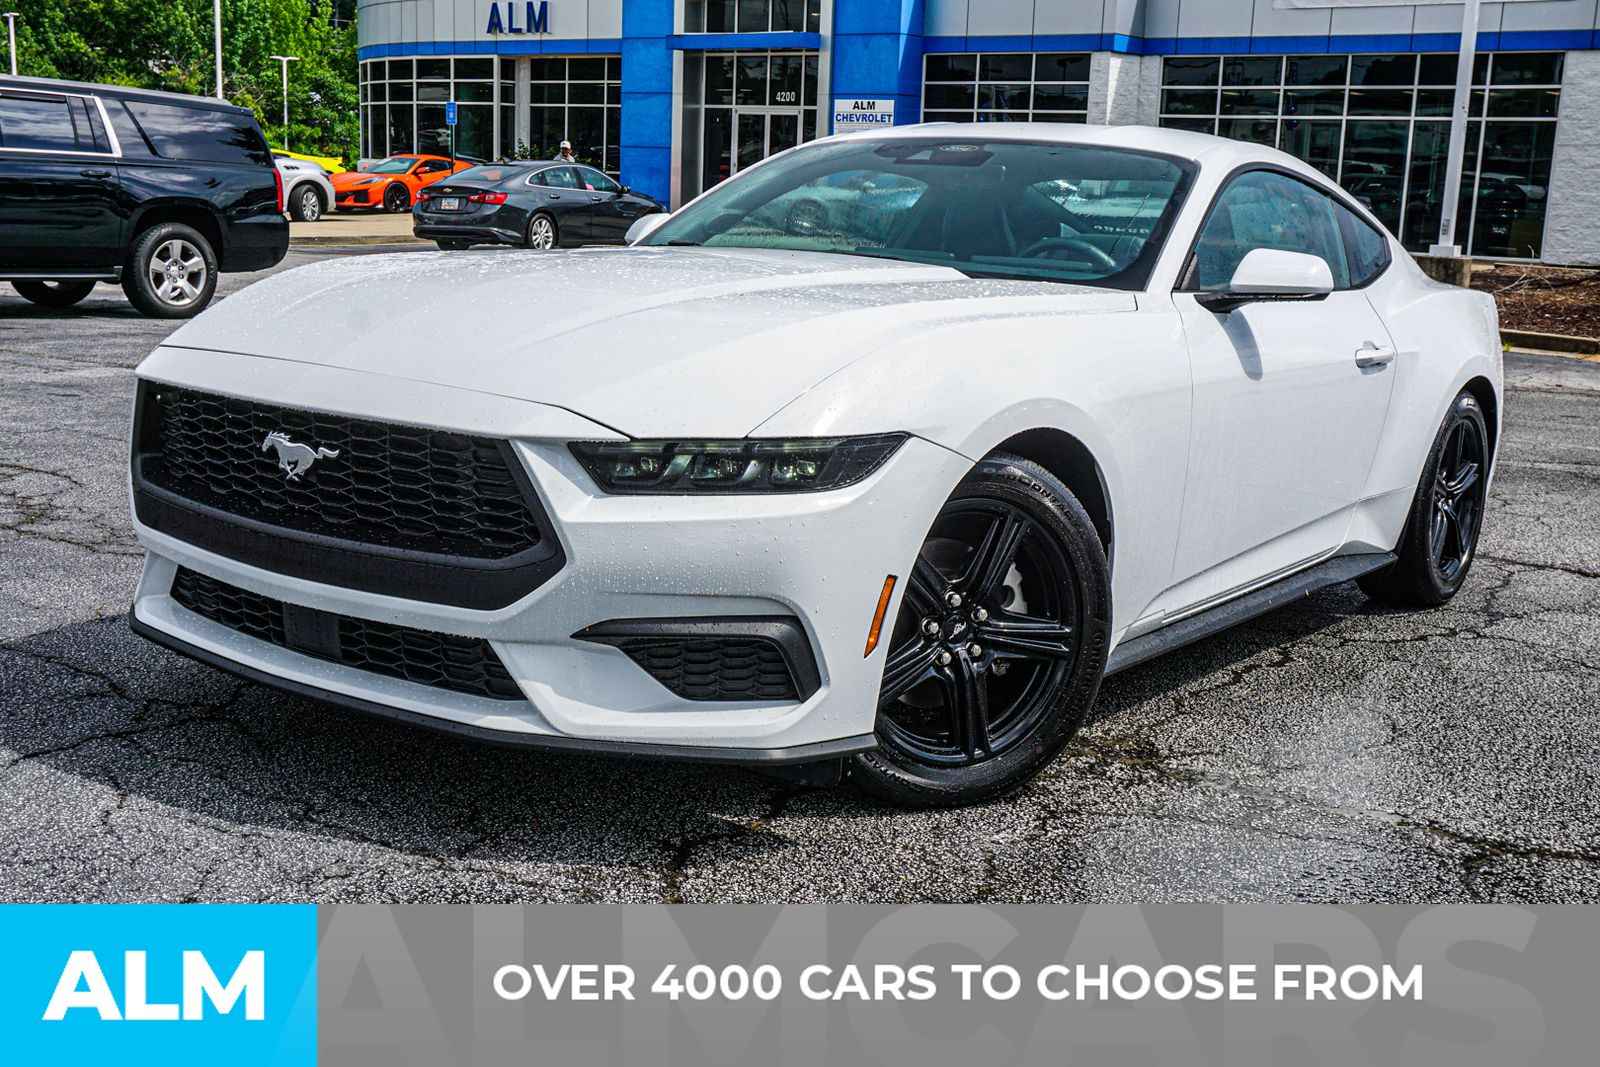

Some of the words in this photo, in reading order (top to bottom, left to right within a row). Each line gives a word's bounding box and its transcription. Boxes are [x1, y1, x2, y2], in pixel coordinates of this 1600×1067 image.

[486, 1, 549, 34] ALM
[775, 91, 796, 102] 4200
[852, 101, 876, 110] ALM
[835, 113, 893, 123] CHEVROLET
